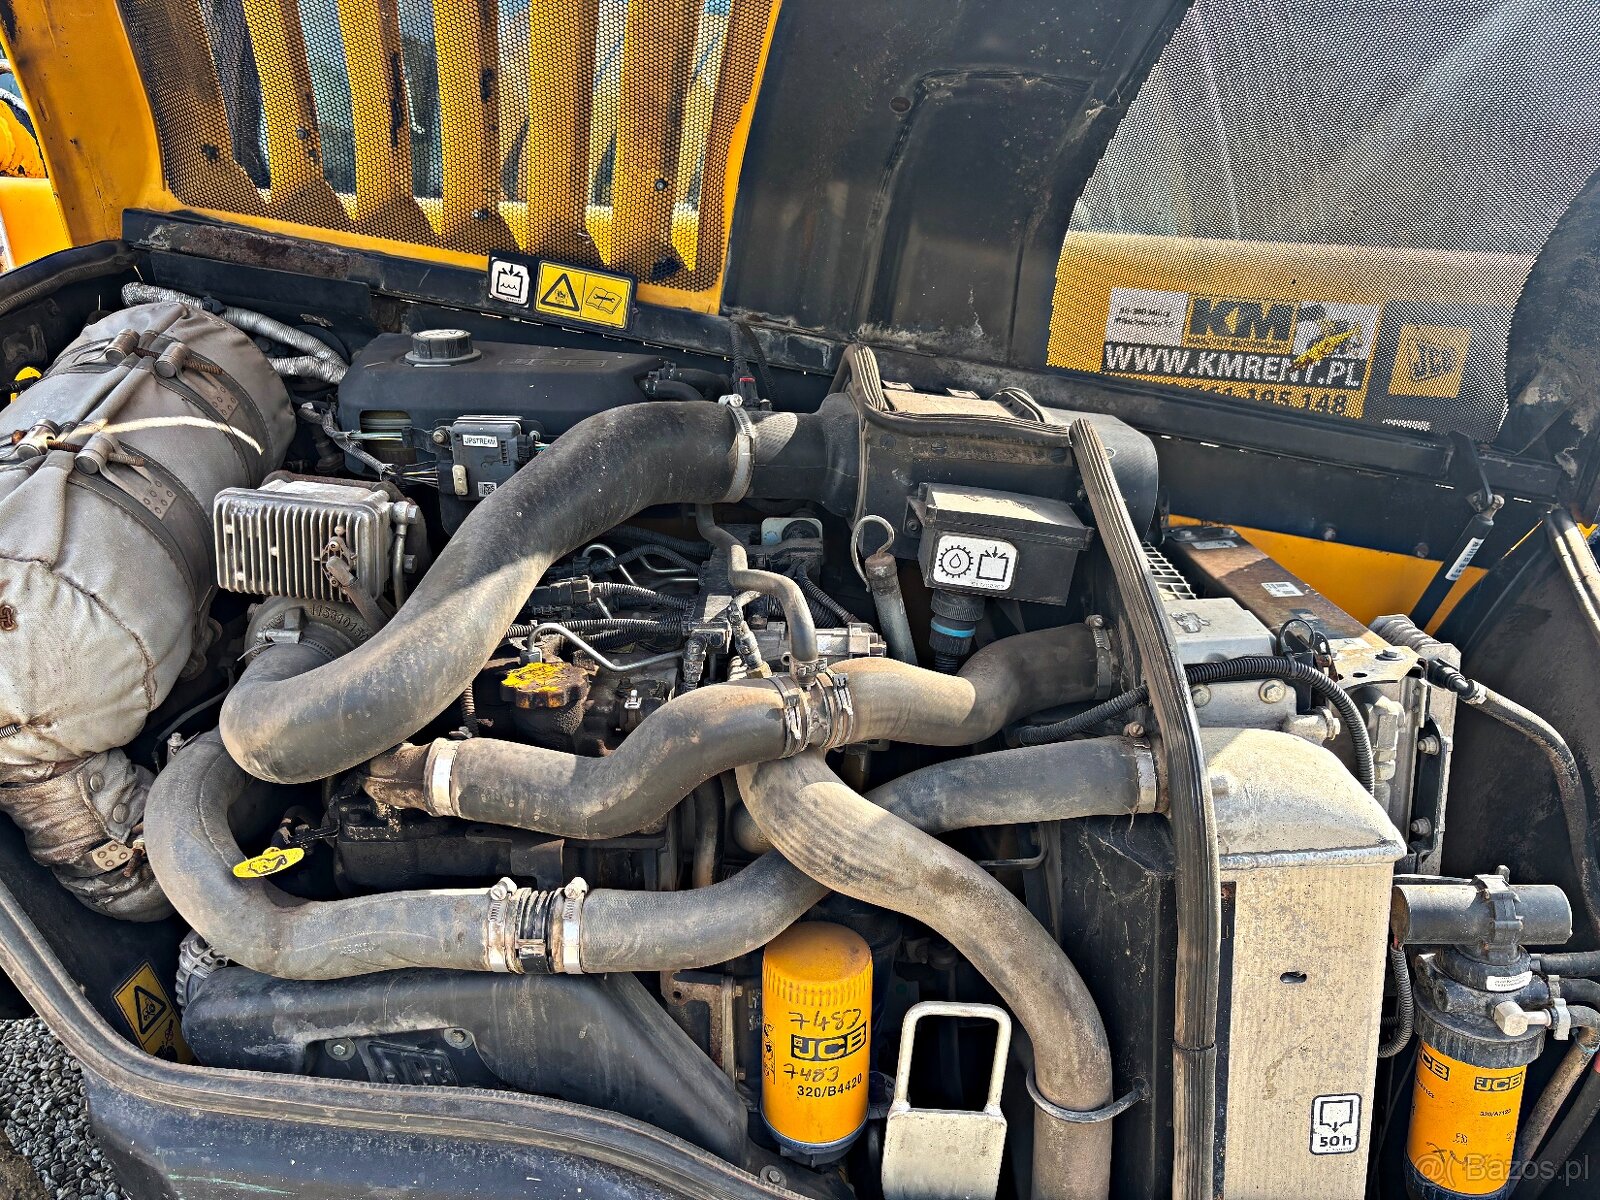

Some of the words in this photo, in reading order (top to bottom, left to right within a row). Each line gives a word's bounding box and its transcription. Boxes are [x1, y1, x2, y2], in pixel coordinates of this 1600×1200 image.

[1190, 299, 1294, 341] KM
[1411, 341, 1457, 380] JCB
[792, 1021, 867, 1061] JCB
[1421, 1046, 1451, 1082] CB
[1474, 1071, 1524, 1092] JCB
[797, 1072, 862, 1099] 320/B4420
